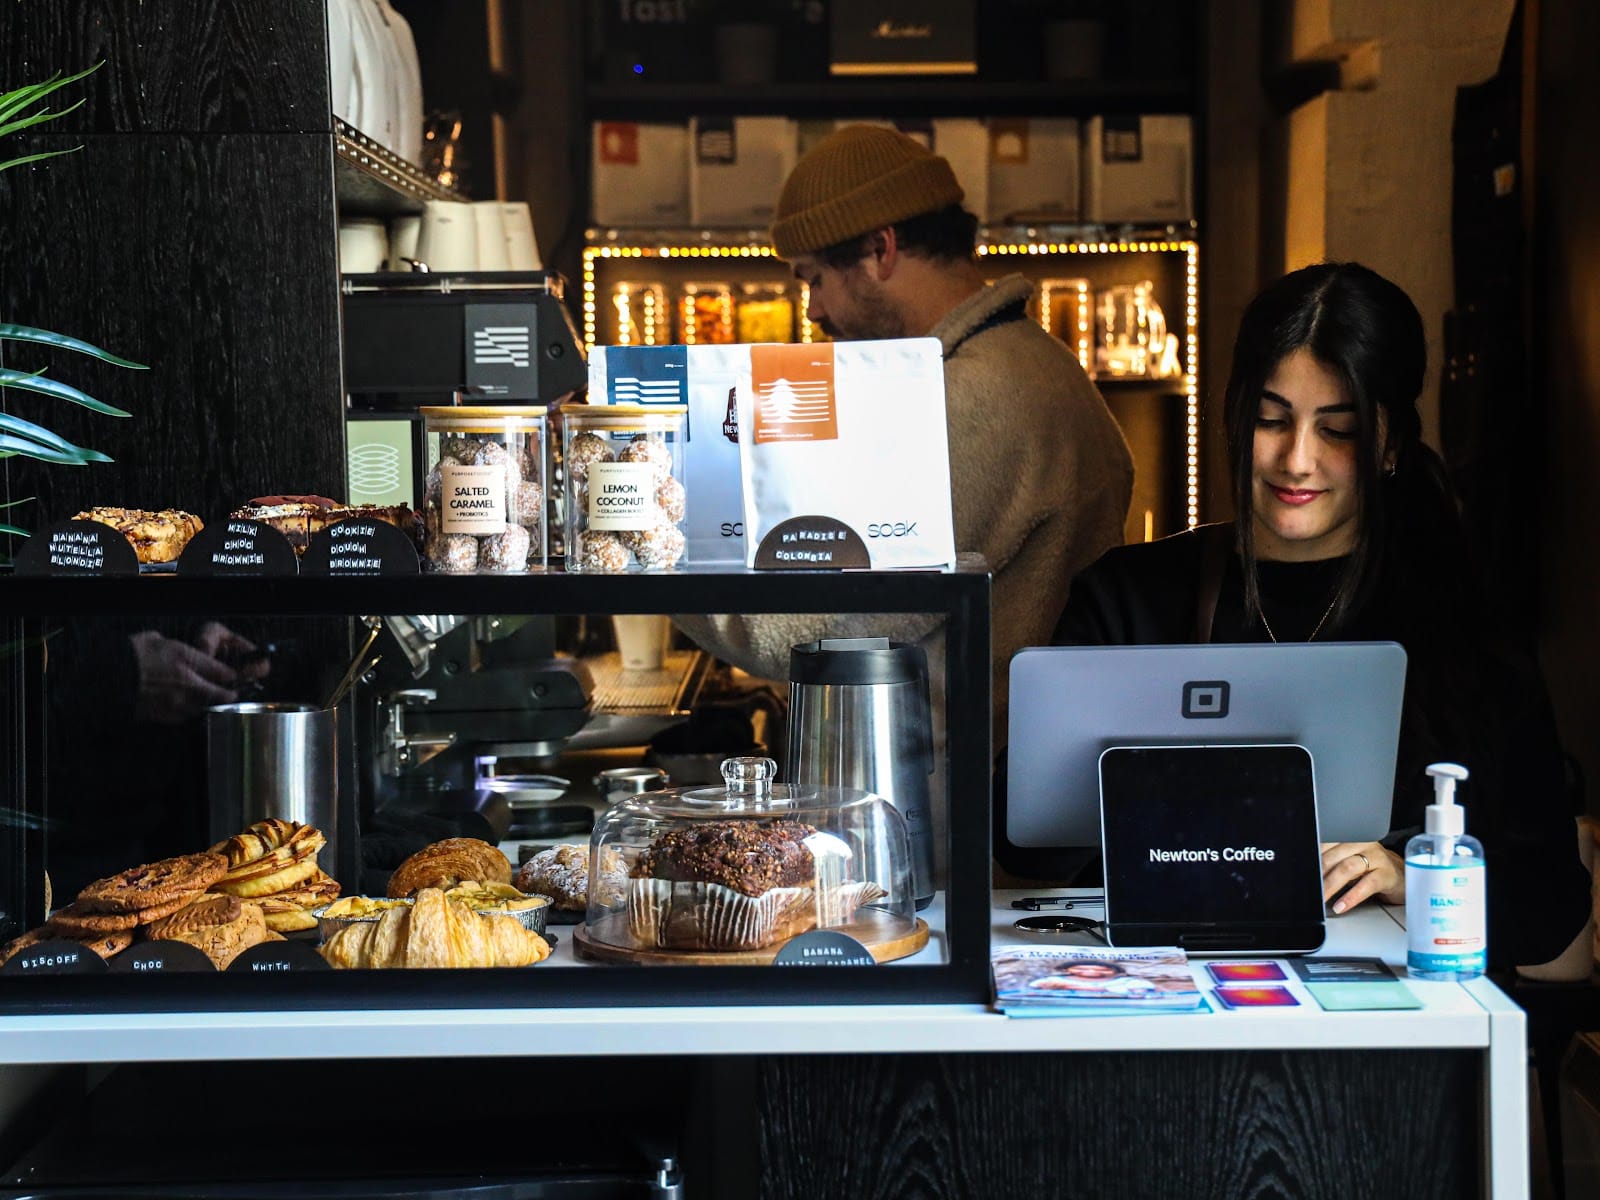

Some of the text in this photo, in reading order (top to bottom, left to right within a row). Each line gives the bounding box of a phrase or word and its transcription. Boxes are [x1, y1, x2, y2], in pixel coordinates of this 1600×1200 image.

[455, 487, 490, 496] SALTED
[603, 484, 638, 493] LEMON
[450, 500, 495, 509] CARAMEL
[596, 497, 644, 506] COCONUT
[227, 523, 257, 536] MILK
[330, 524, 375, 537] COOKIE
[868, 519, 919, 538] soak
[52, 532, 98, 544] BANANA
[224, 538, 254, 550] CHOC
[49, 543, 103, 557] NUTELLA
[330, 542, 367, 554] DOUGH
[50, 555, 104, 568] BLONDIE
[212, 553, 264, 565] BROWNIE
[329, 558, 382, 569] BROWNIE
[1149, 847, 1276, 862] Newton's Coffee
[803, 948, 843, 957] BANANA
[22, 954, 78, 969] BISCOFF
[133, 960, 163, 971] CHOC
